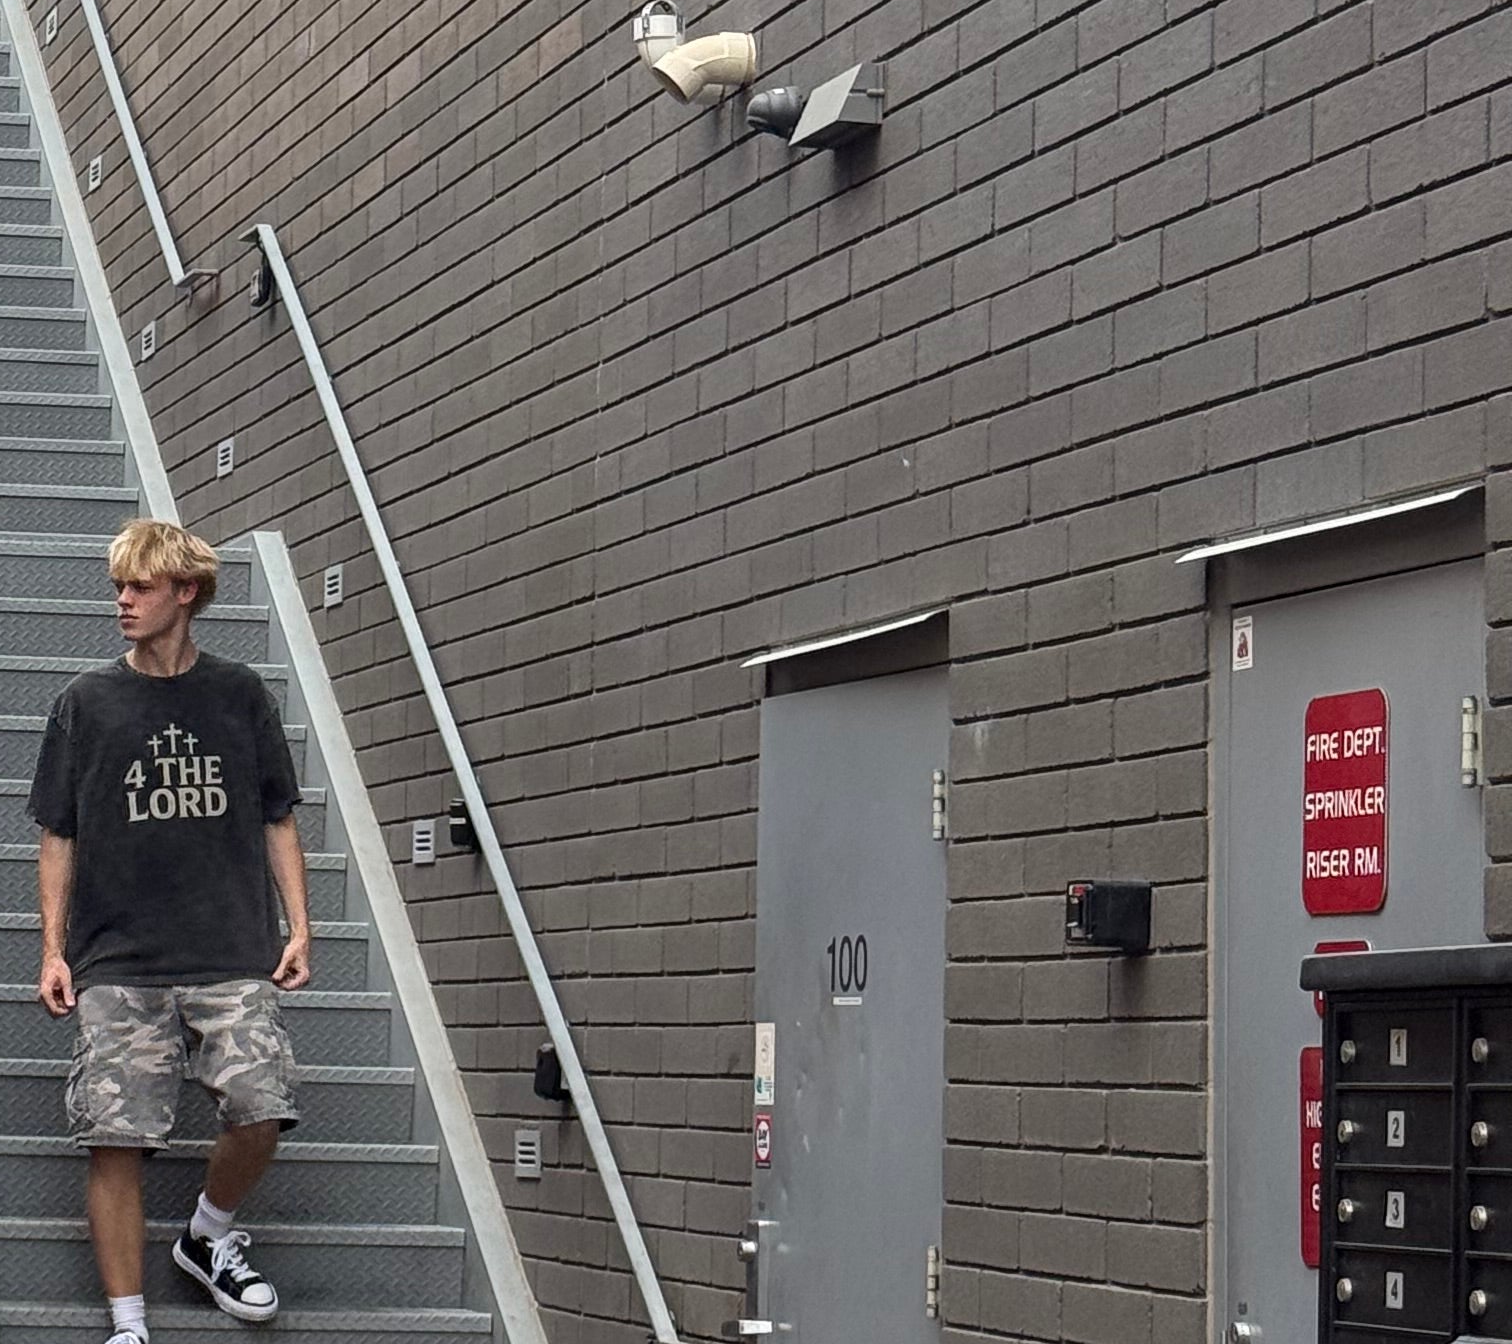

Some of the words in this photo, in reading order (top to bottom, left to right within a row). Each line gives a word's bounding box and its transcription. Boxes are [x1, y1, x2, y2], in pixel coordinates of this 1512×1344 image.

[1306, 731, 1339, 763] FIRE
[1343, 726, 1385, 758] DEPT.
[124, 760, 147, 789] 4
[154, 755, 224, 787] THE
[126, 786, 228, 822] LORD
[1304, 786, 1385, 821] SPRINKLER
[1306, 848, 1350, 879] RISER
[1354, 846, 1382, 876] RM.
[826, 934, 868, 993] 100
[1391, 1116, 1400, 1140] 2
[1391, 1197, 1400, 1221] 3
[1390, 1278, 1399, 1302] 4
